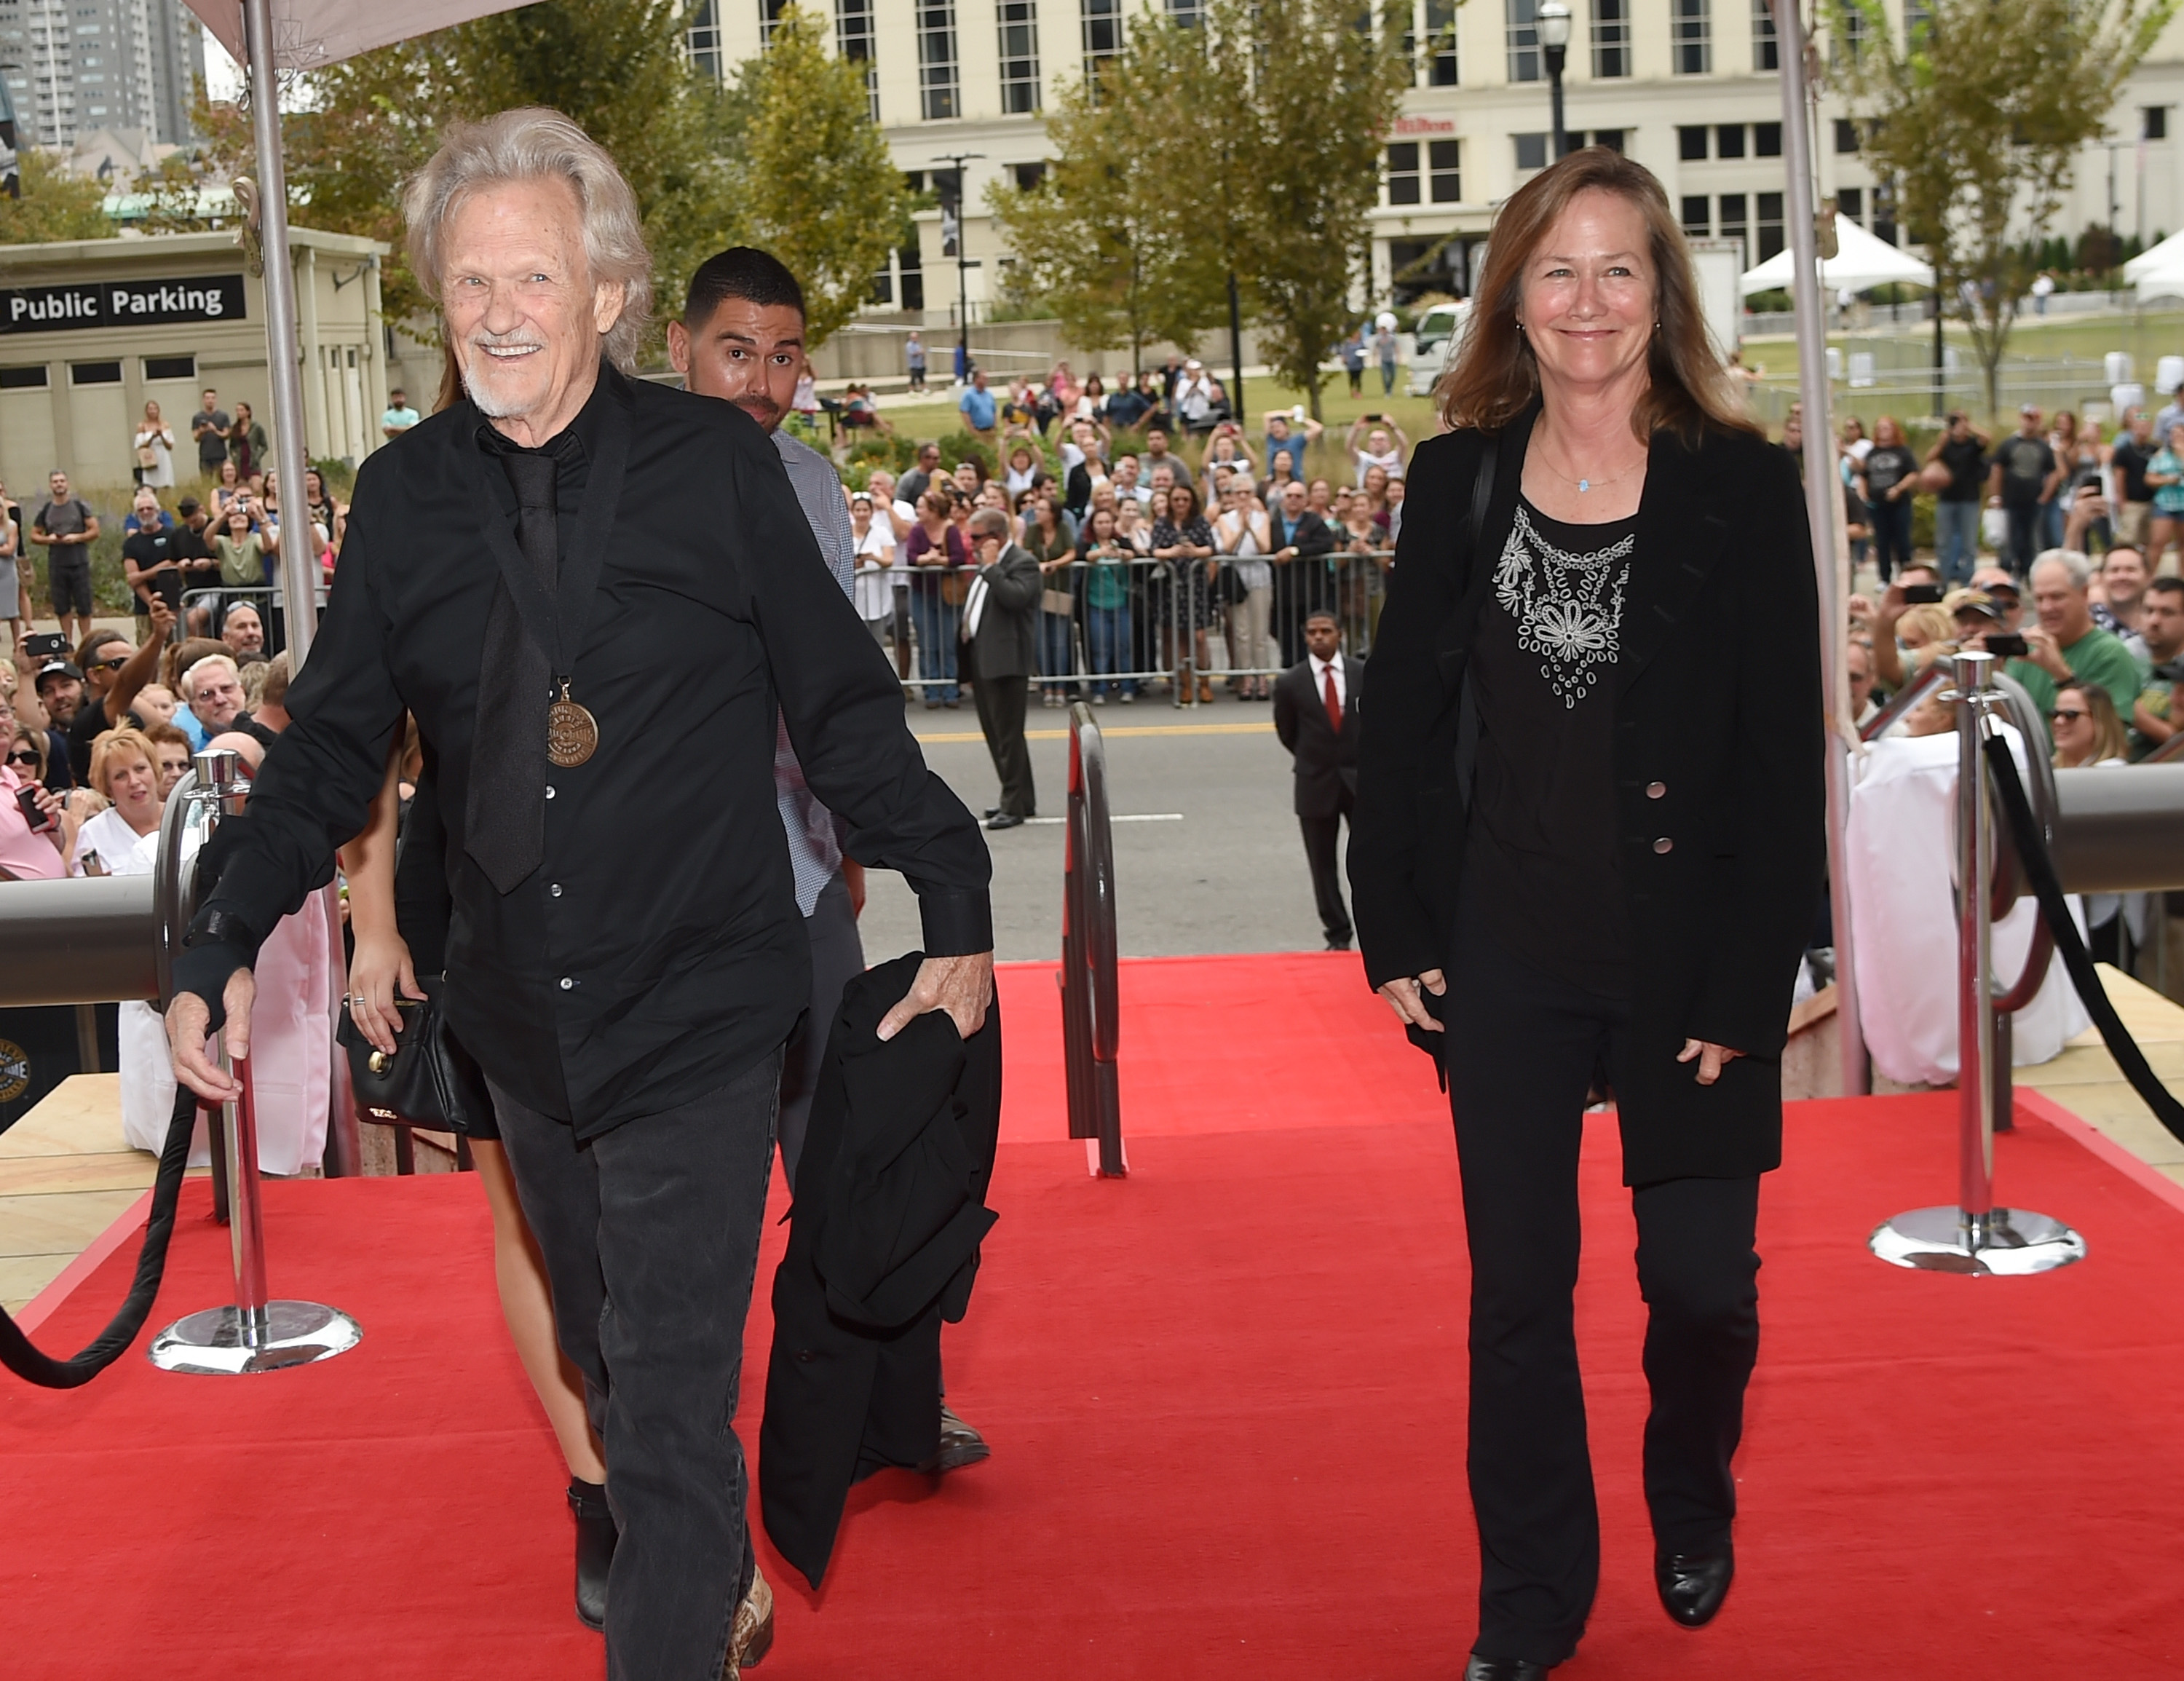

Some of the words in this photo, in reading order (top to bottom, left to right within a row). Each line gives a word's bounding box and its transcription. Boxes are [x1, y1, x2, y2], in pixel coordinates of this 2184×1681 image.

[1394, 116, 1455, 134] Hilton
[9, 292, 98, 321] Public
[112, 285, 223, 316] Parking
